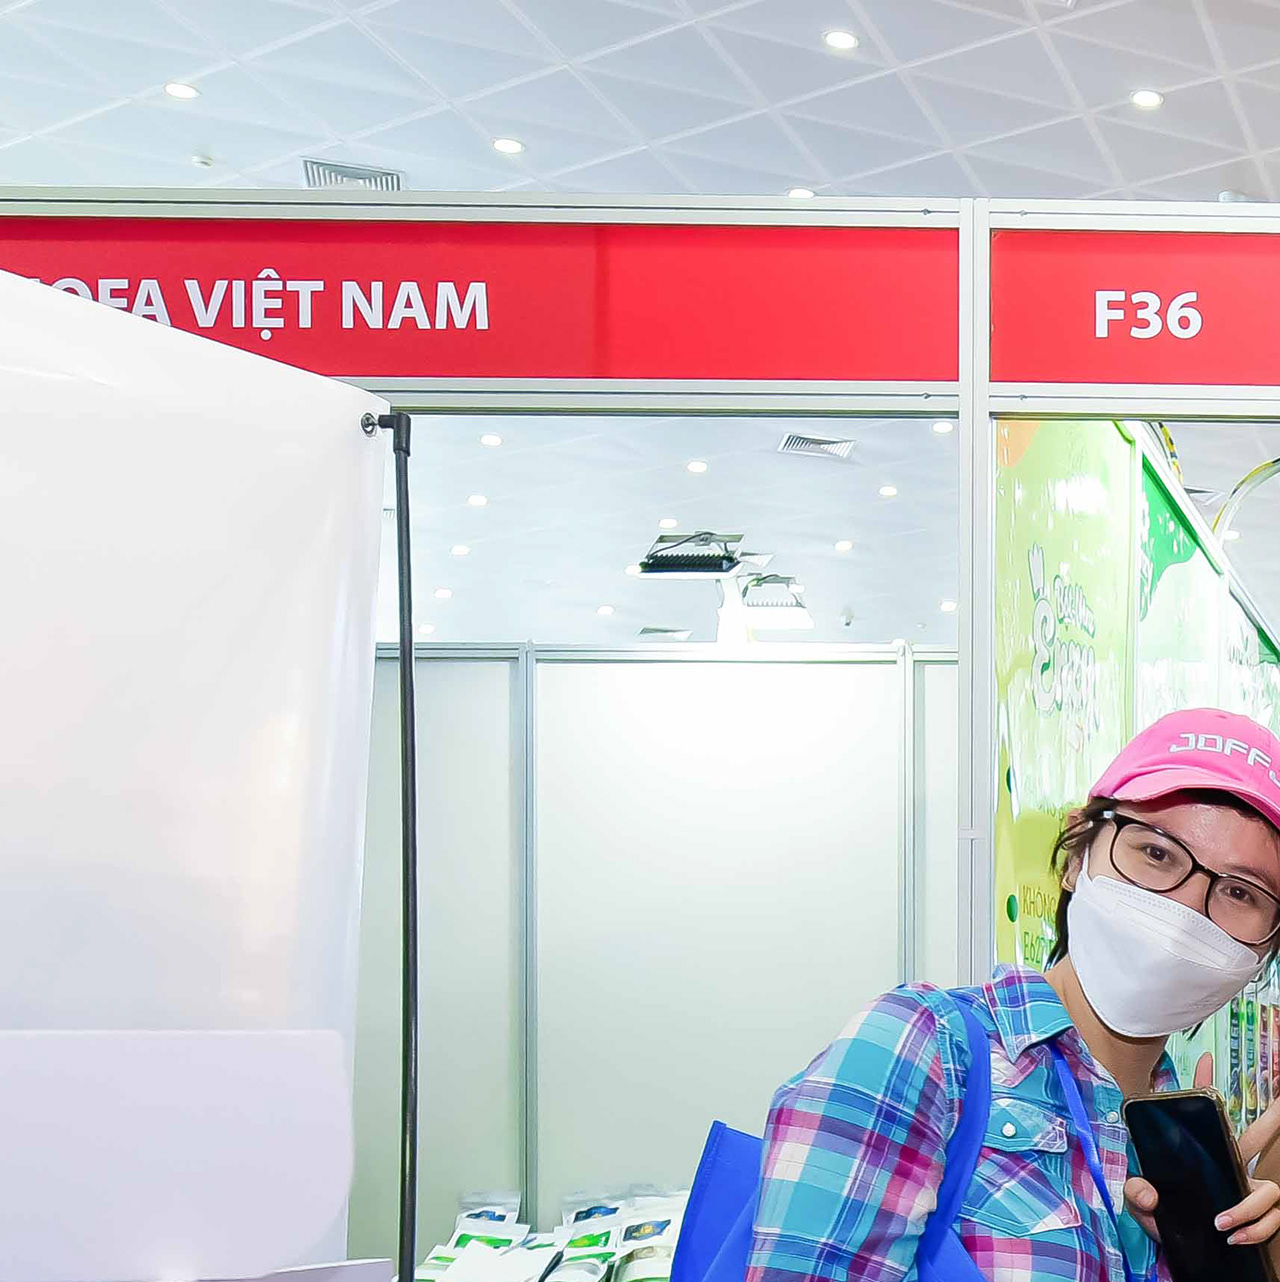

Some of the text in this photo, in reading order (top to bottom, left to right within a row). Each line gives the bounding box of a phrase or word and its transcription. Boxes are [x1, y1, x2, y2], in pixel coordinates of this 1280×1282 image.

[184, 268, 325, 341] VIỆT
[341, 281, 489, 330] NAM
[1095, 290, 1202, 340] F36
